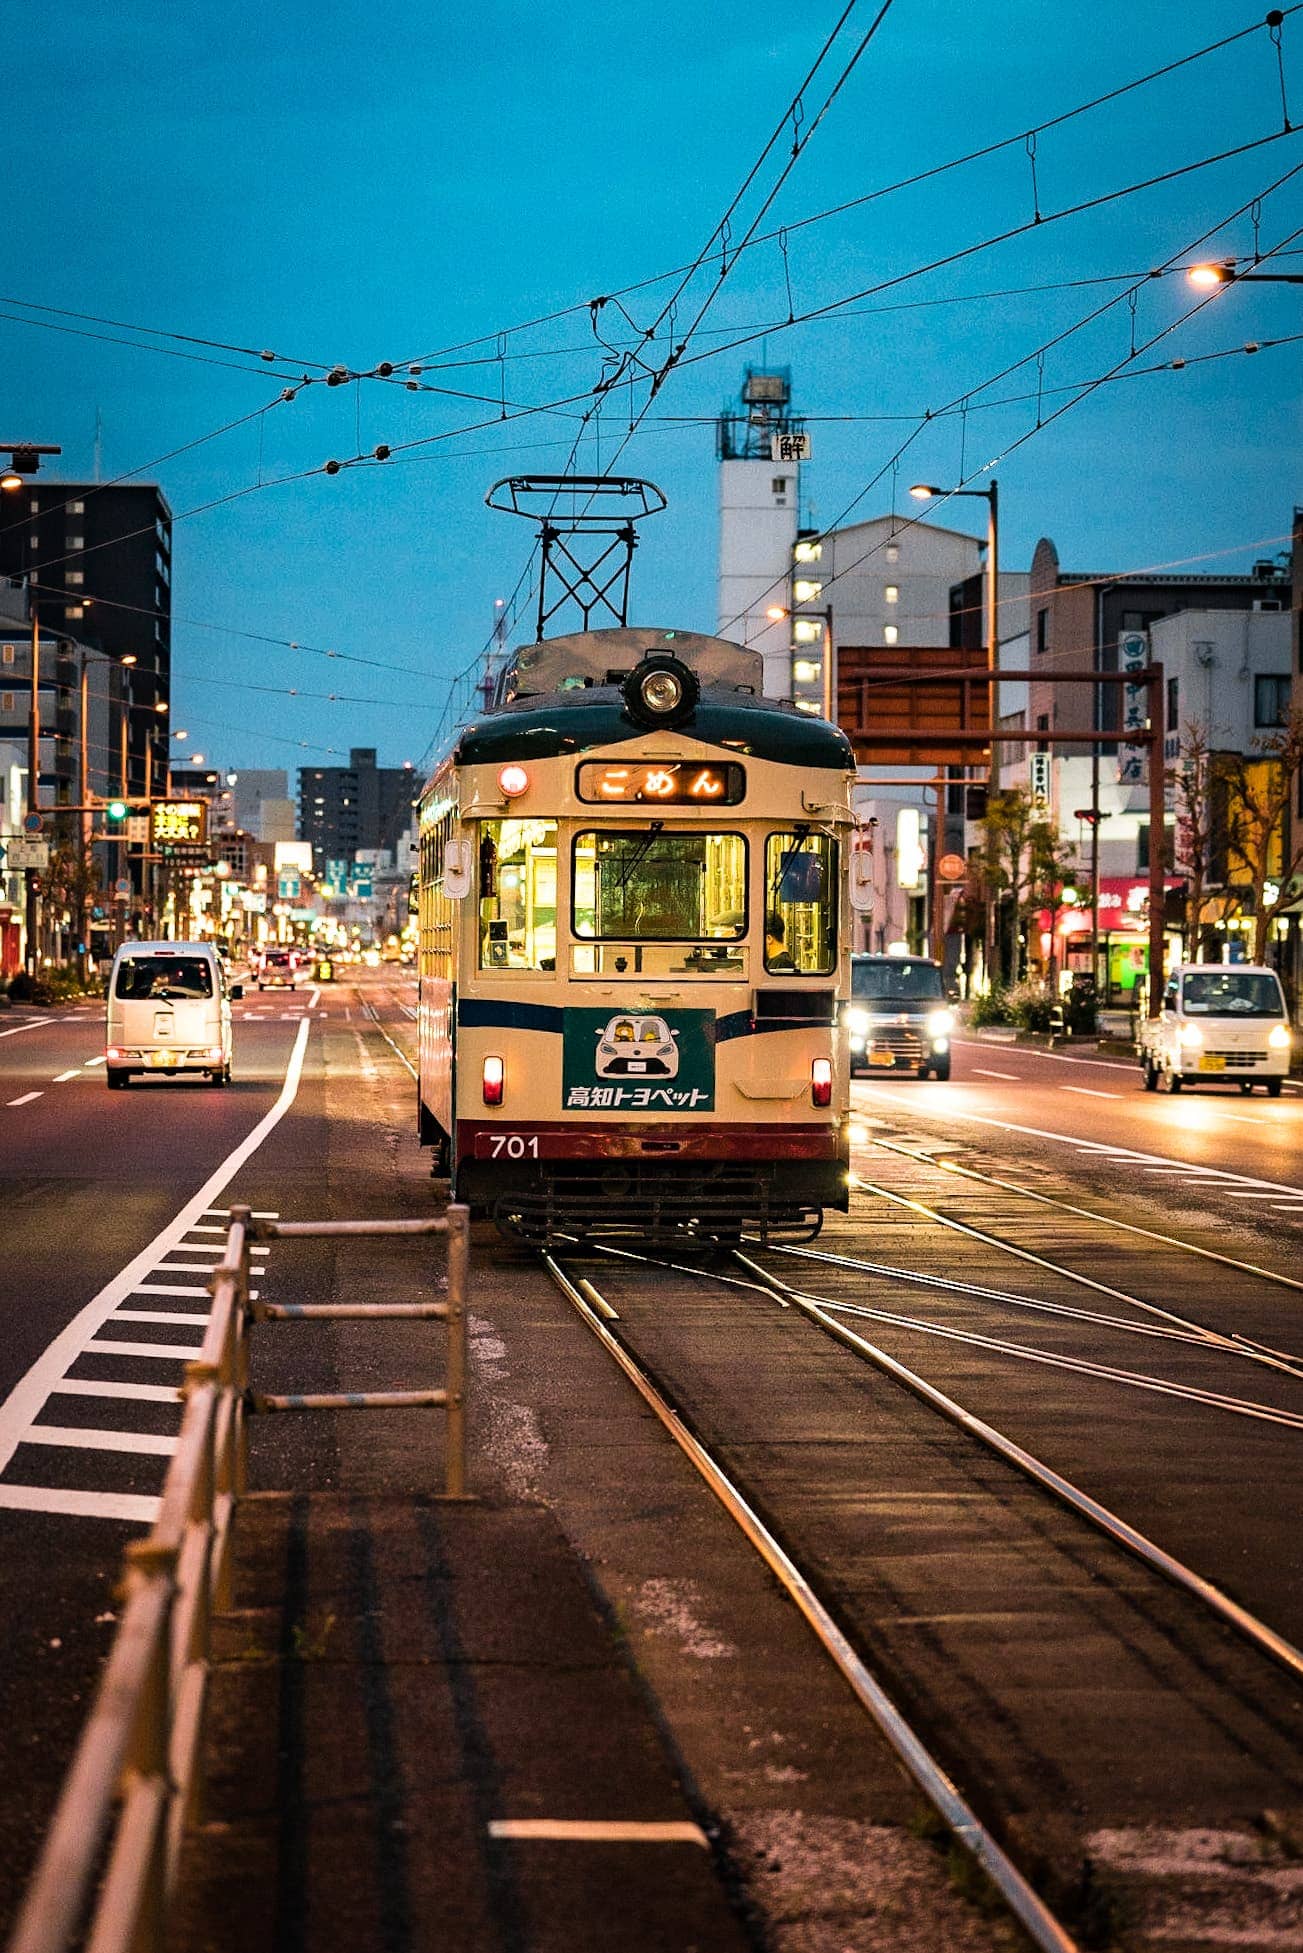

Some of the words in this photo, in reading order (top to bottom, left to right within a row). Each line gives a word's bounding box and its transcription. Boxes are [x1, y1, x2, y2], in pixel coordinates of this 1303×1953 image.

[567, 1086, 709, 1107] 高知トヨペット
[490, 1136, 538, 1158] 701
